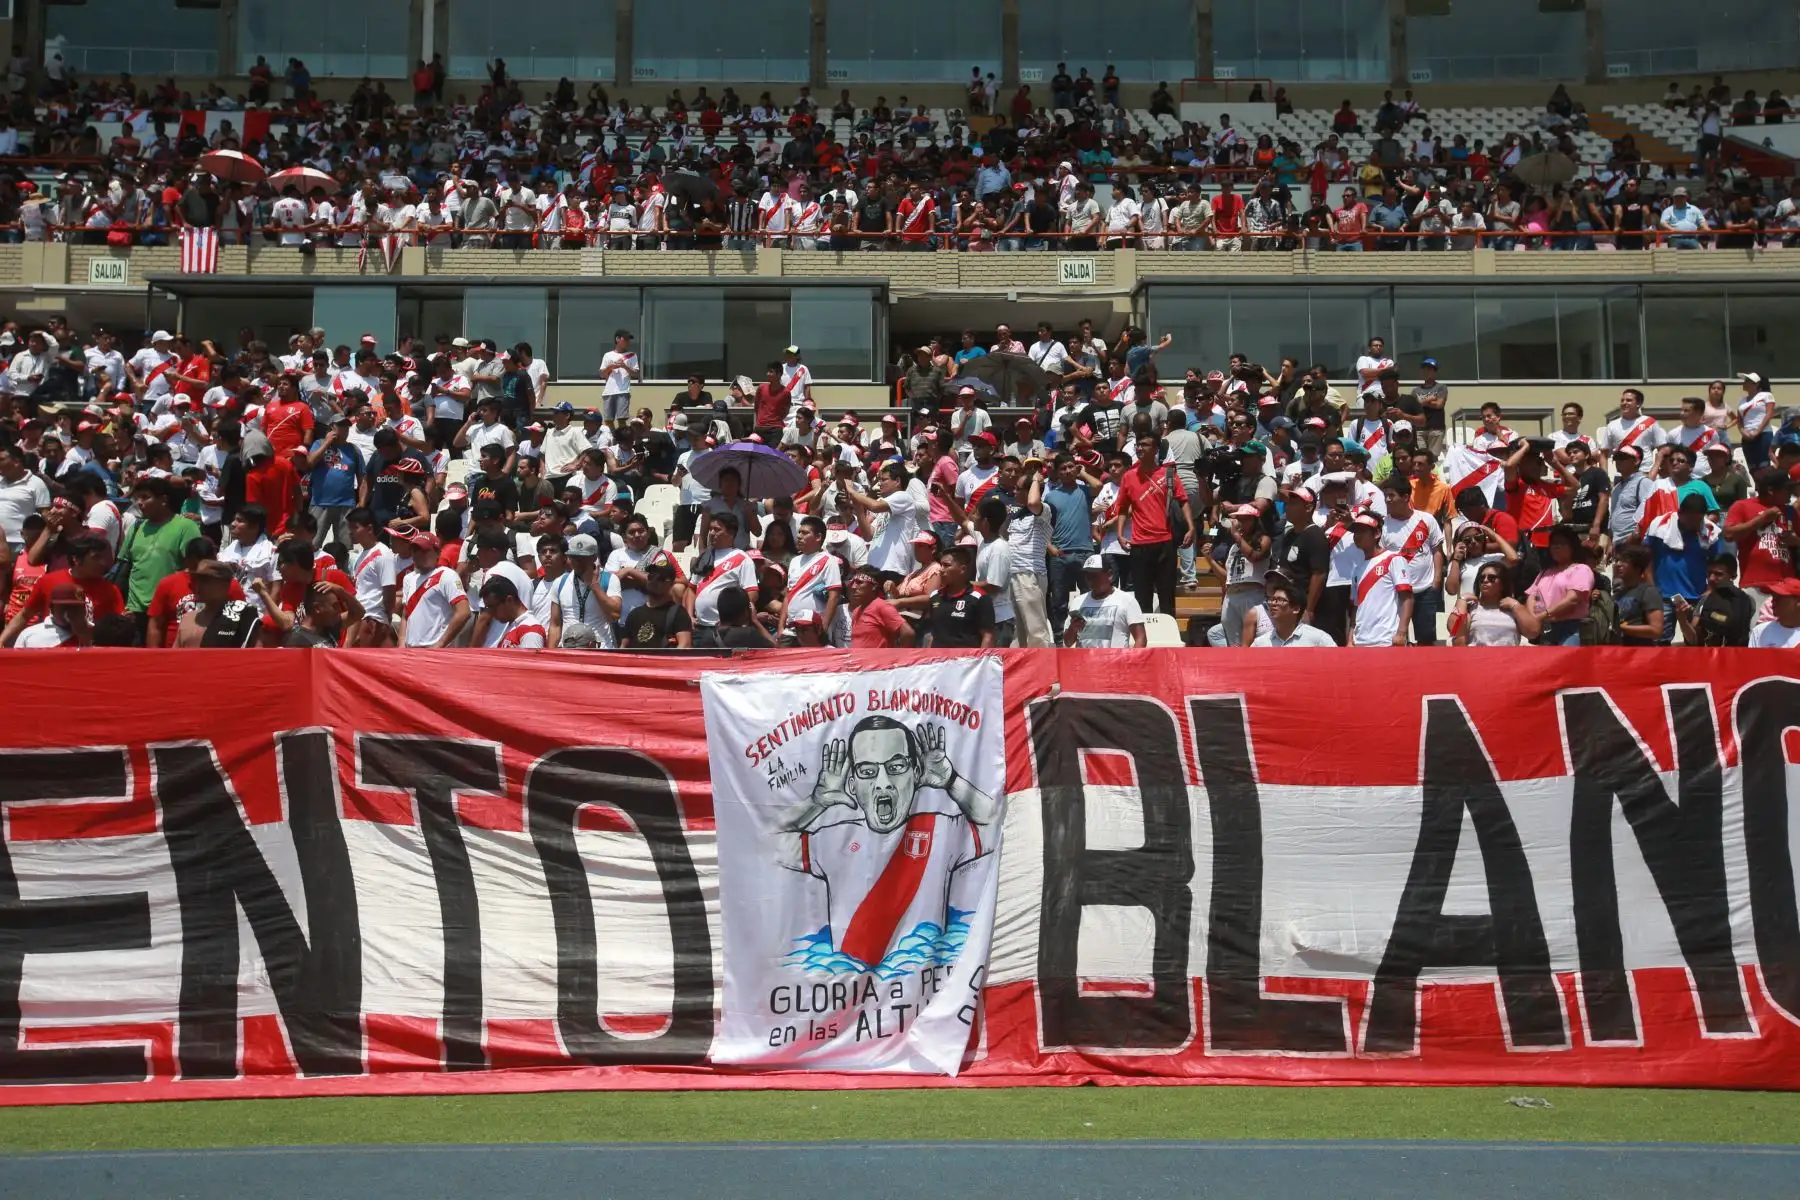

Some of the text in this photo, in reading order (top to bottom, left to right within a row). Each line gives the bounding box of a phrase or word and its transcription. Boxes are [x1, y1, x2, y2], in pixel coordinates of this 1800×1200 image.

[95, 263, 122, 279] SALIDA
[1063, 263, 1090, 279] SALIDA
[376, 475, 399, 483] adida
[768, 757, 785, 775] LA
[768, 762, 807, 791] FAMILIA
[0, 726, 714, 1087] ENTO
[770, 976, 879, 1014] GLORIA
[890, 981, 903, 999] a
[769, 1025, 797, 1047] en
[809, 1019, 838, 1041] las
